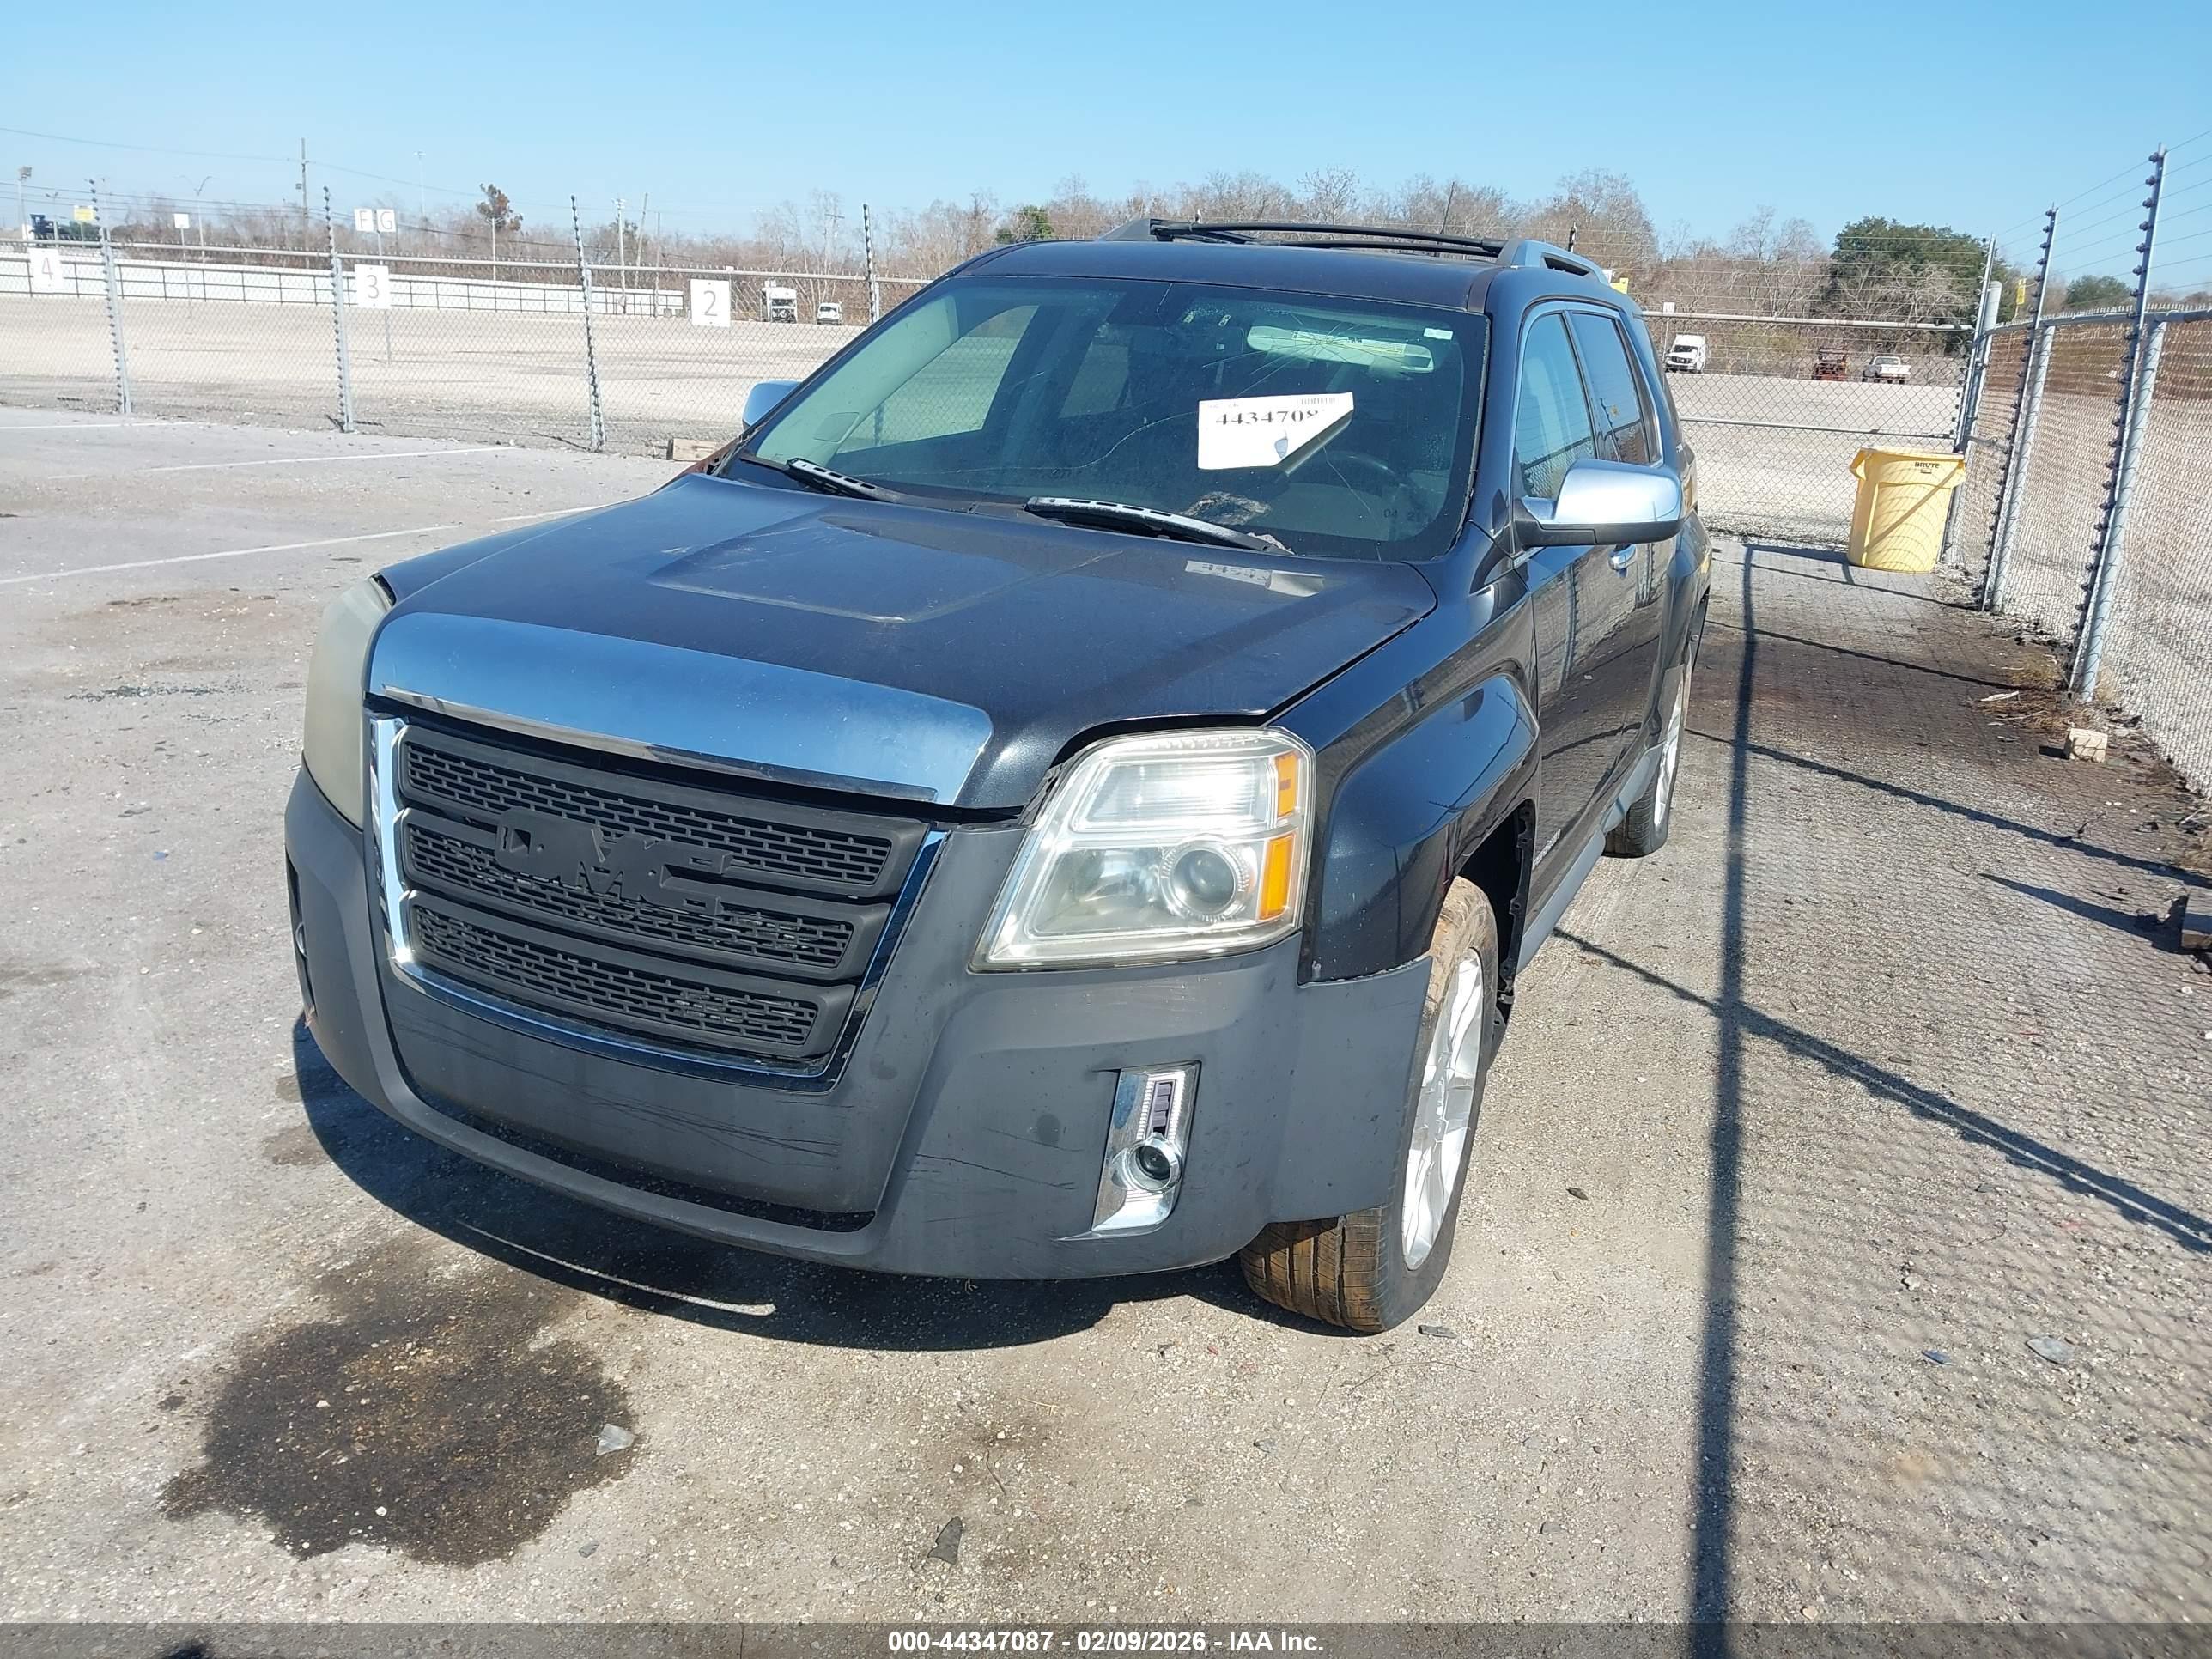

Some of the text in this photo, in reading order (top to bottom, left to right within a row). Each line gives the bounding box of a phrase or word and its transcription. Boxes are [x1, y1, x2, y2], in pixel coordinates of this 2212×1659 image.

[358, 210, 368, 229] F
[380, 210, 393, 230] G
[41, 256, 54, 281] 4
[366, 274, 380, 299] 3
[702, 289, 718, 317] 2
